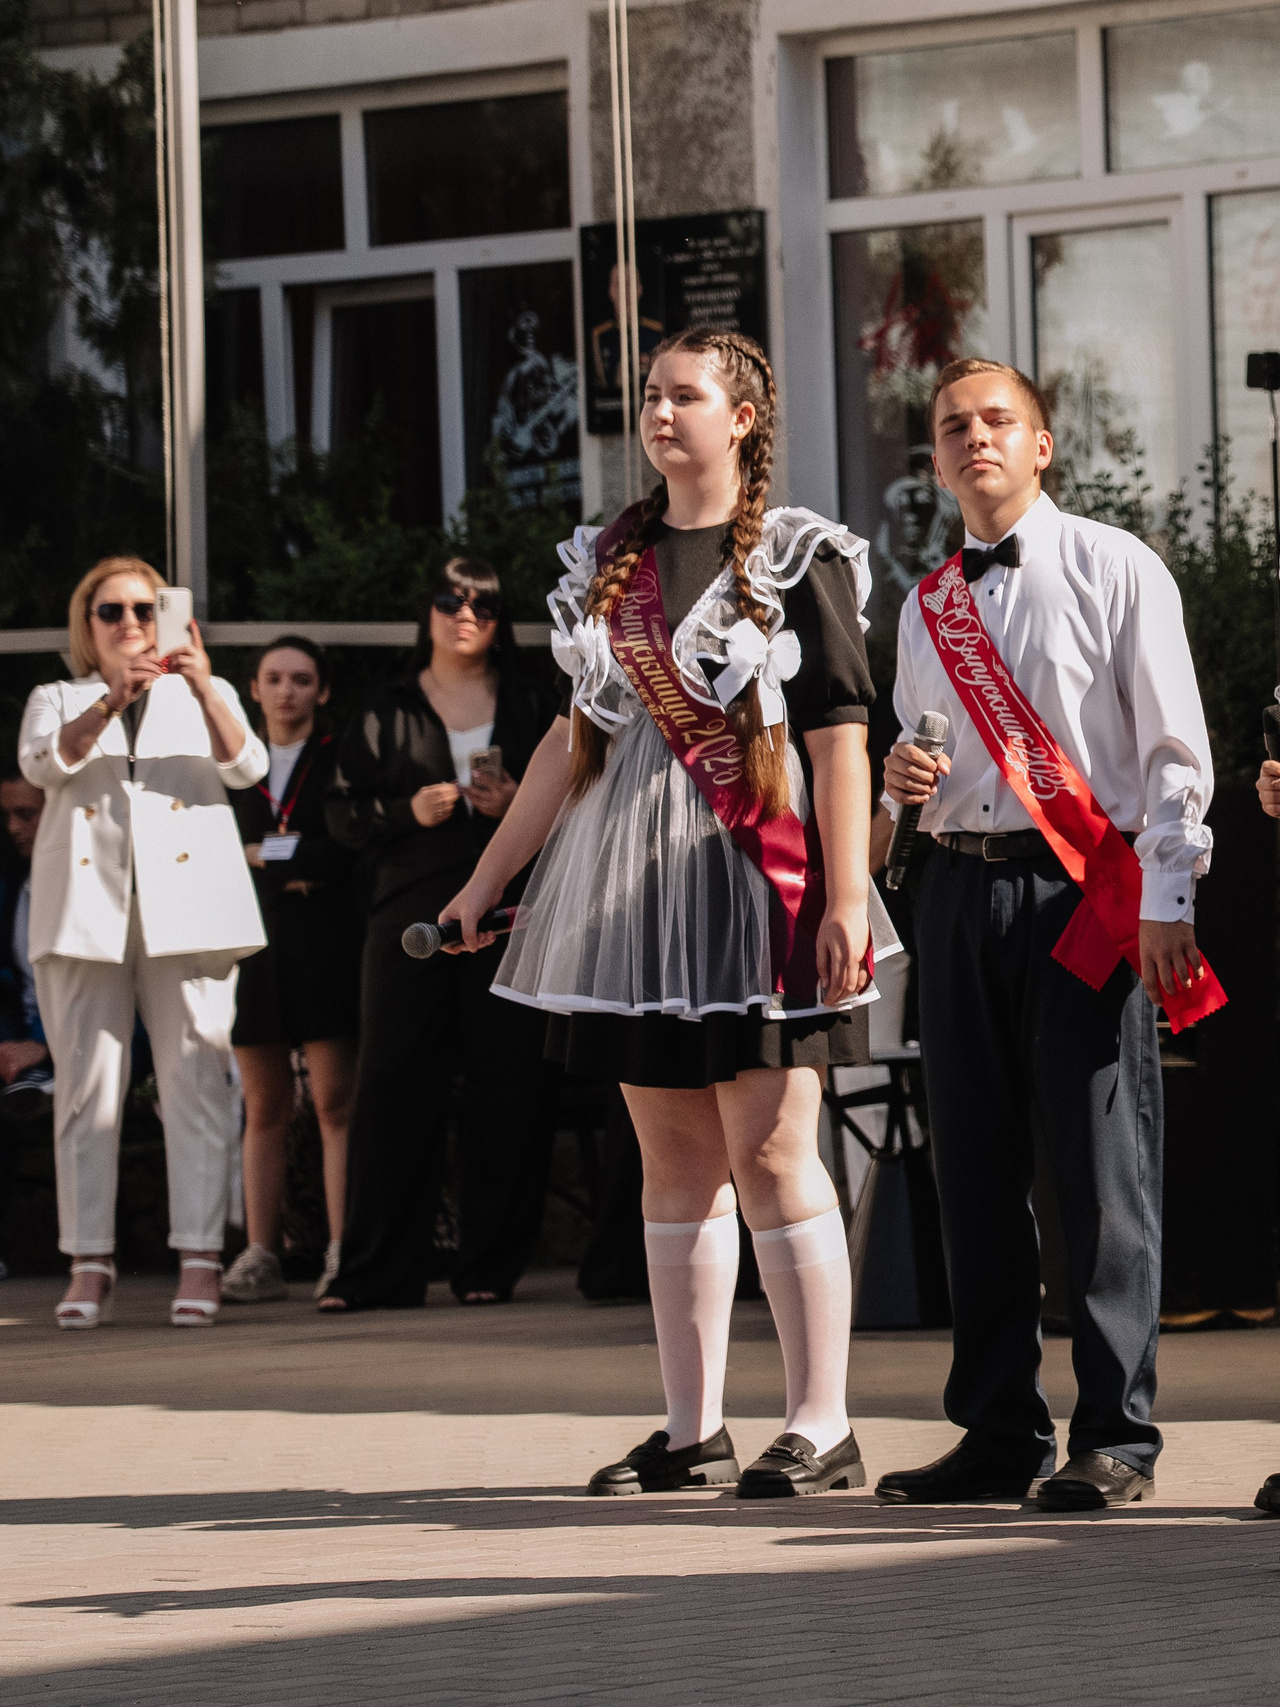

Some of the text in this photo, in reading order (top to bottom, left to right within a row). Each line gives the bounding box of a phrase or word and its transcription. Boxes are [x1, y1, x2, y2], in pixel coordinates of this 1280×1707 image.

[613, 567, 699, 729] Выпускница
[936, 608, 1078, 801] Выпускник 2025
